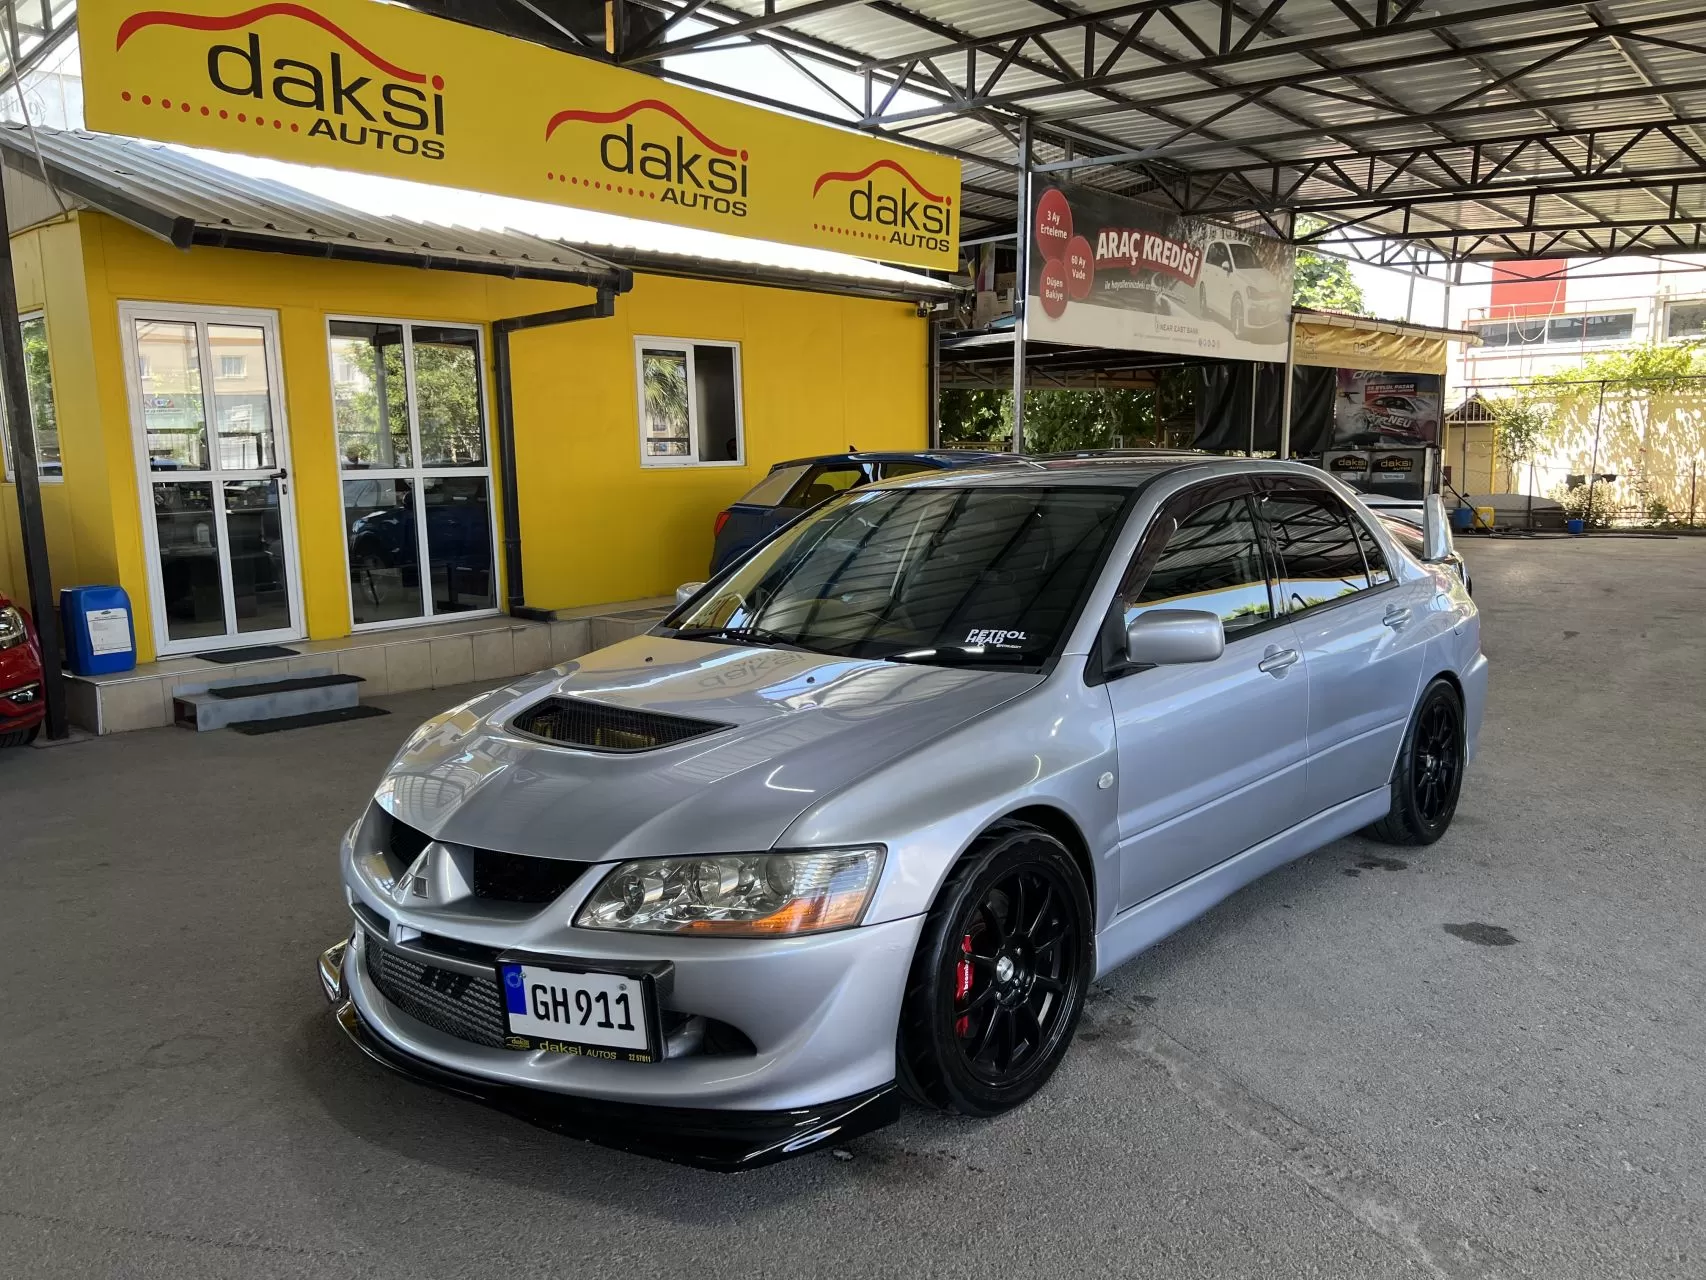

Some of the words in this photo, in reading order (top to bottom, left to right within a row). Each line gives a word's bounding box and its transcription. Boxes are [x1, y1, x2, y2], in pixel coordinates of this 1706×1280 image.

[206, 31, 445, 136] daksi
[307, 117, 446, 160] AUTOS
[600, 123, 749, 198] daksi
[659, 187, 748, 218] AUTOS
[849, 180, 951, 236] daksi
[1047, 210, 1052, 221] 3
[1052, 211, 1061, 225] Ay
[1040, 223, 1068, 239] Erteleme
[889, 229, 951, 253] AUTOS
[1078, 256, 1086, 269] Ay
[1096, 232, 1140, 265] ARAÇ
[1142, 235, 1200, 279] KREDİSİ
[1071, 268, 1086, 280] Vade
[1046, 276, 1064, 289] Düşen
[1045, 289, 1064, 302] Bakiye
[1338, 458, 1367, 466] daksi
[1380, 459, 1412, 468] daksi
[967, 629, 1027, 640] PETROL
[539, 1040, 582, 1056] daksi
[586, 1049, 617, 1060] AUTOS
